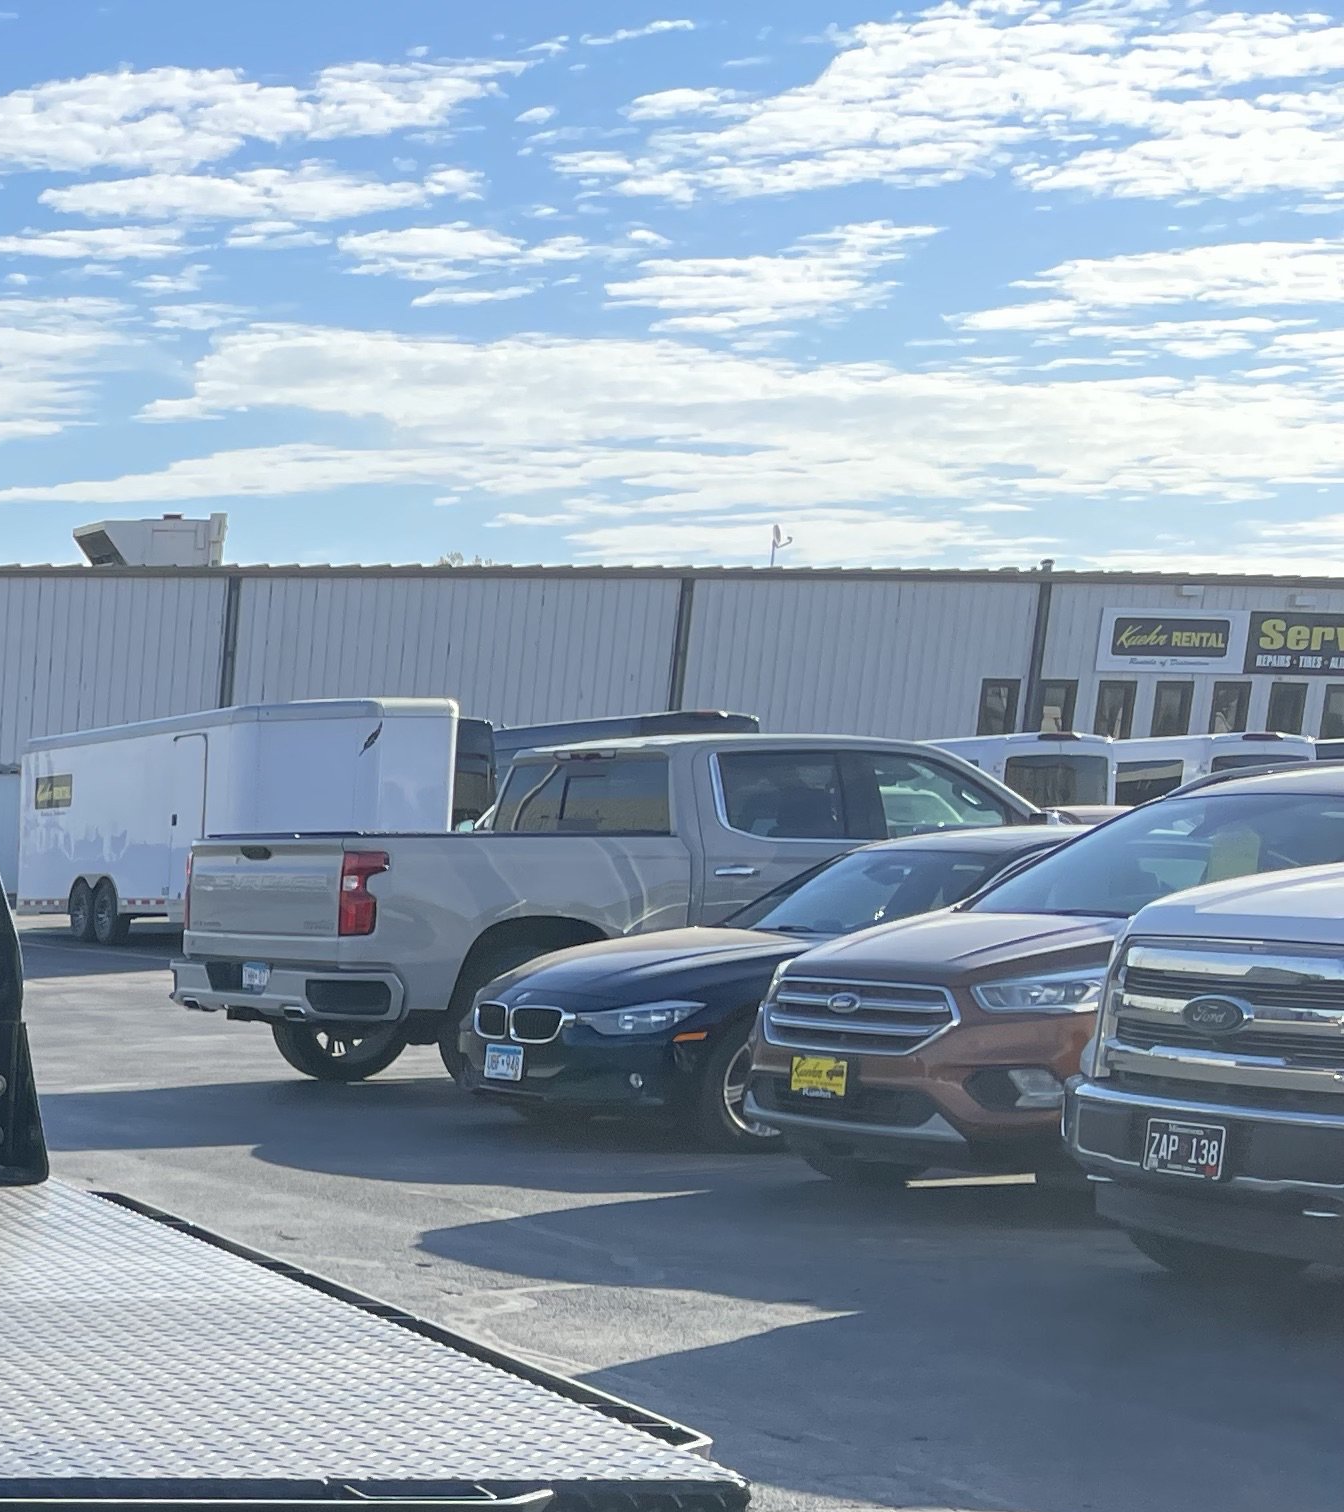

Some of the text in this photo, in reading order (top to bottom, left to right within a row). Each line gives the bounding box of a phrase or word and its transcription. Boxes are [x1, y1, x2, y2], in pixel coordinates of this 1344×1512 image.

[1116, 624, 1226, 649] Kuehn RENTAL
[1255, 654, 1292, 668] REPAIRS
[1298, 655, 1323, 669] TIRES
[1192, 1003, 1227, 1023] Ford
[1149, 1132, 1219, 1166] ZAP 138
